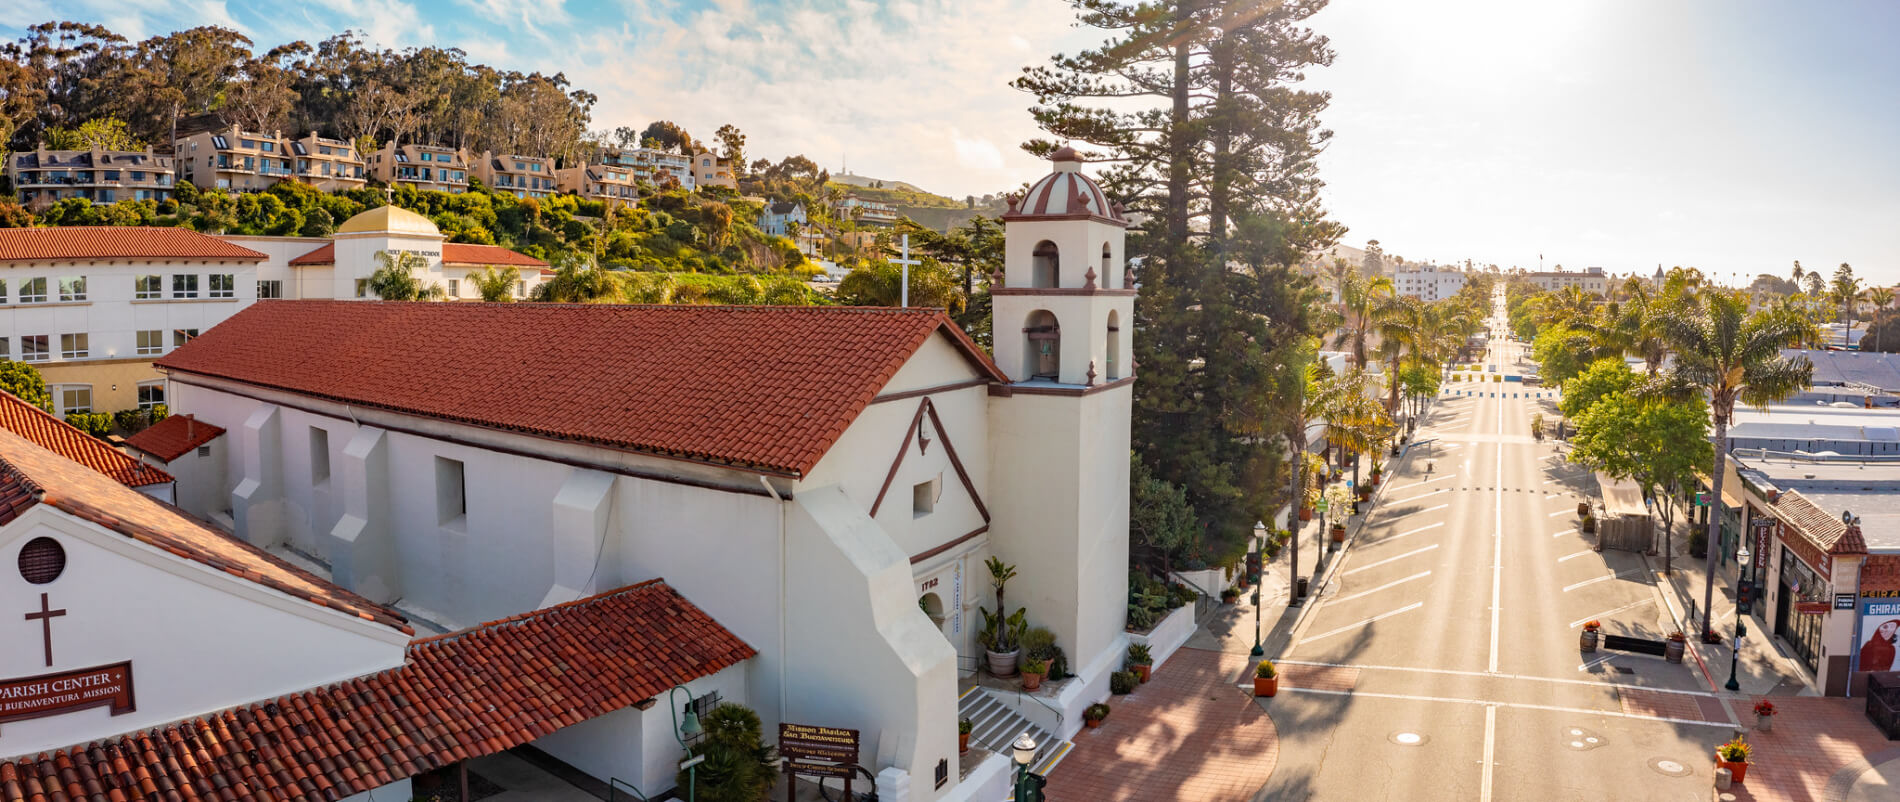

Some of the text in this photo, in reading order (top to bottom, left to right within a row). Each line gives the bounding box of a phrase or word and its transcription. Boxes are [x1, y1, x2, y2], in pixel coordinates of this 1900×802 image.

[52, 673, 111, 692] CENTER
[5, 693, 80, 710] BUENAVENTURA
[83, 685, 121, 699] MISSION
